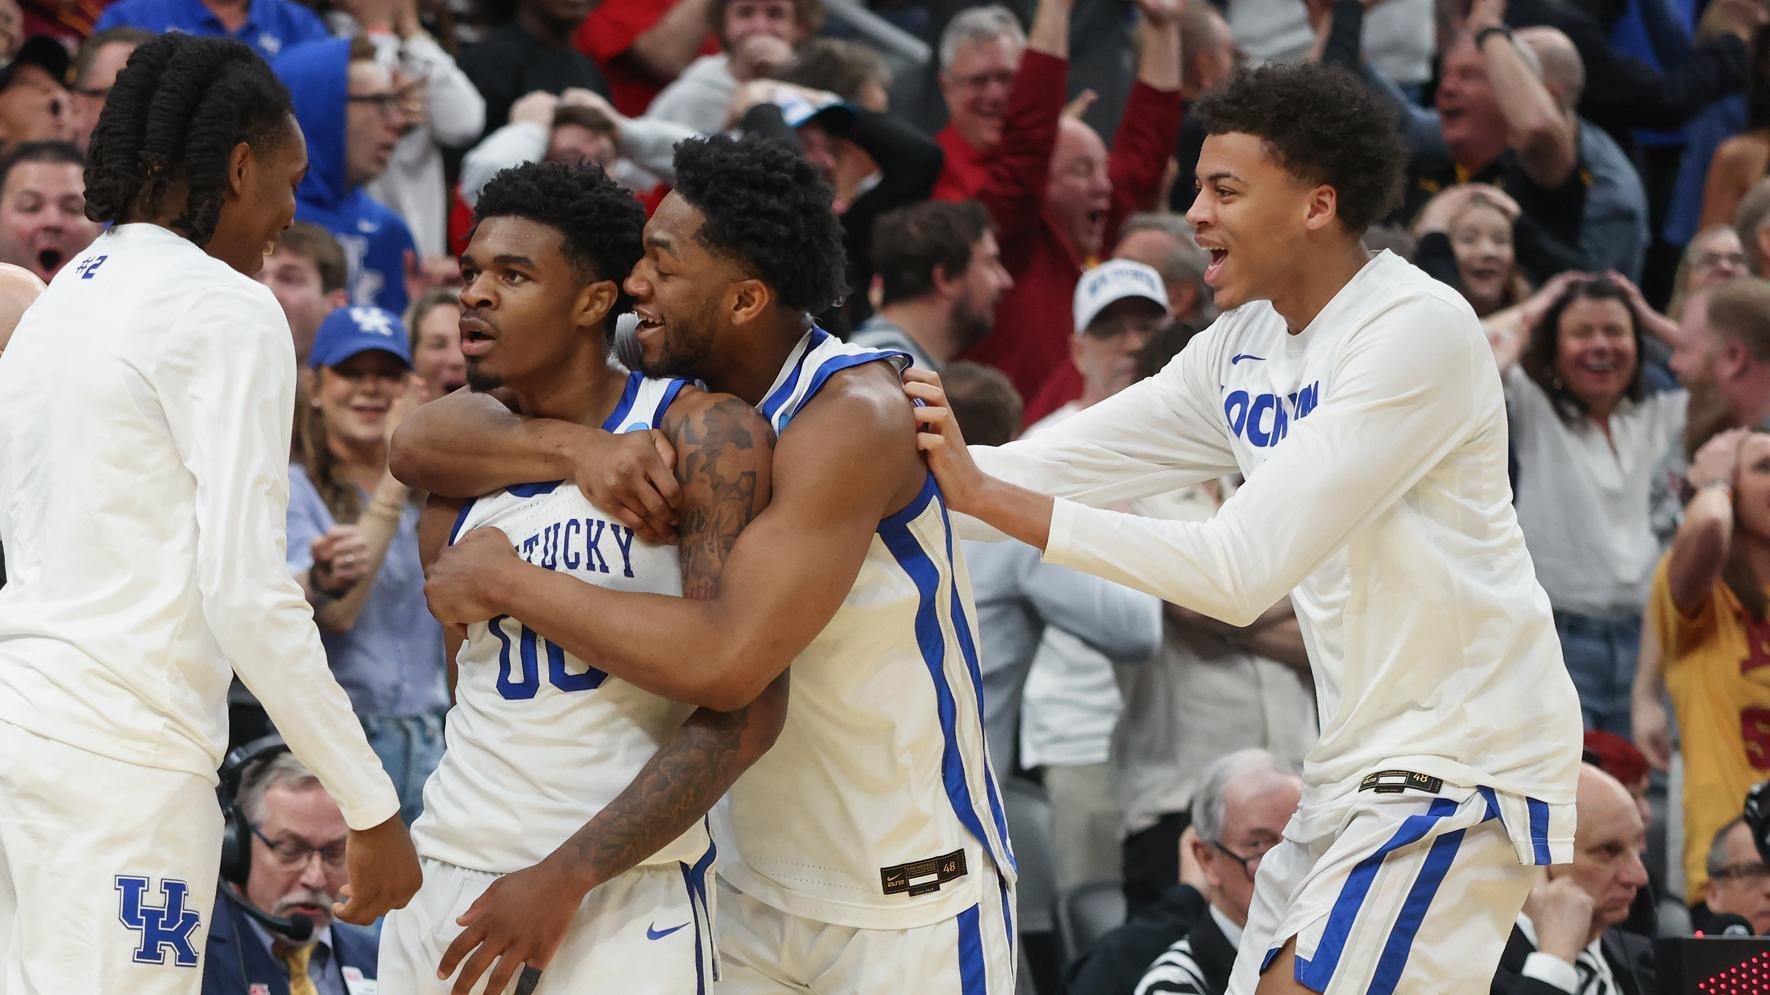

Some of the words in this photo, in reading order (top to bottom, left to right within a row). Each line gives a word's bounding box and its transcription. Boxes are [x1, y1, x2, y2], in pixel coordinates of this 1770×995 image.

[76, 255, 108, 279] #2
[515, 518, 635, 578] TUCKY
[1413, 773, 1429, 783] 48
[943, 861, 956, 873] 48
[114, 874, 201, 968] UK
